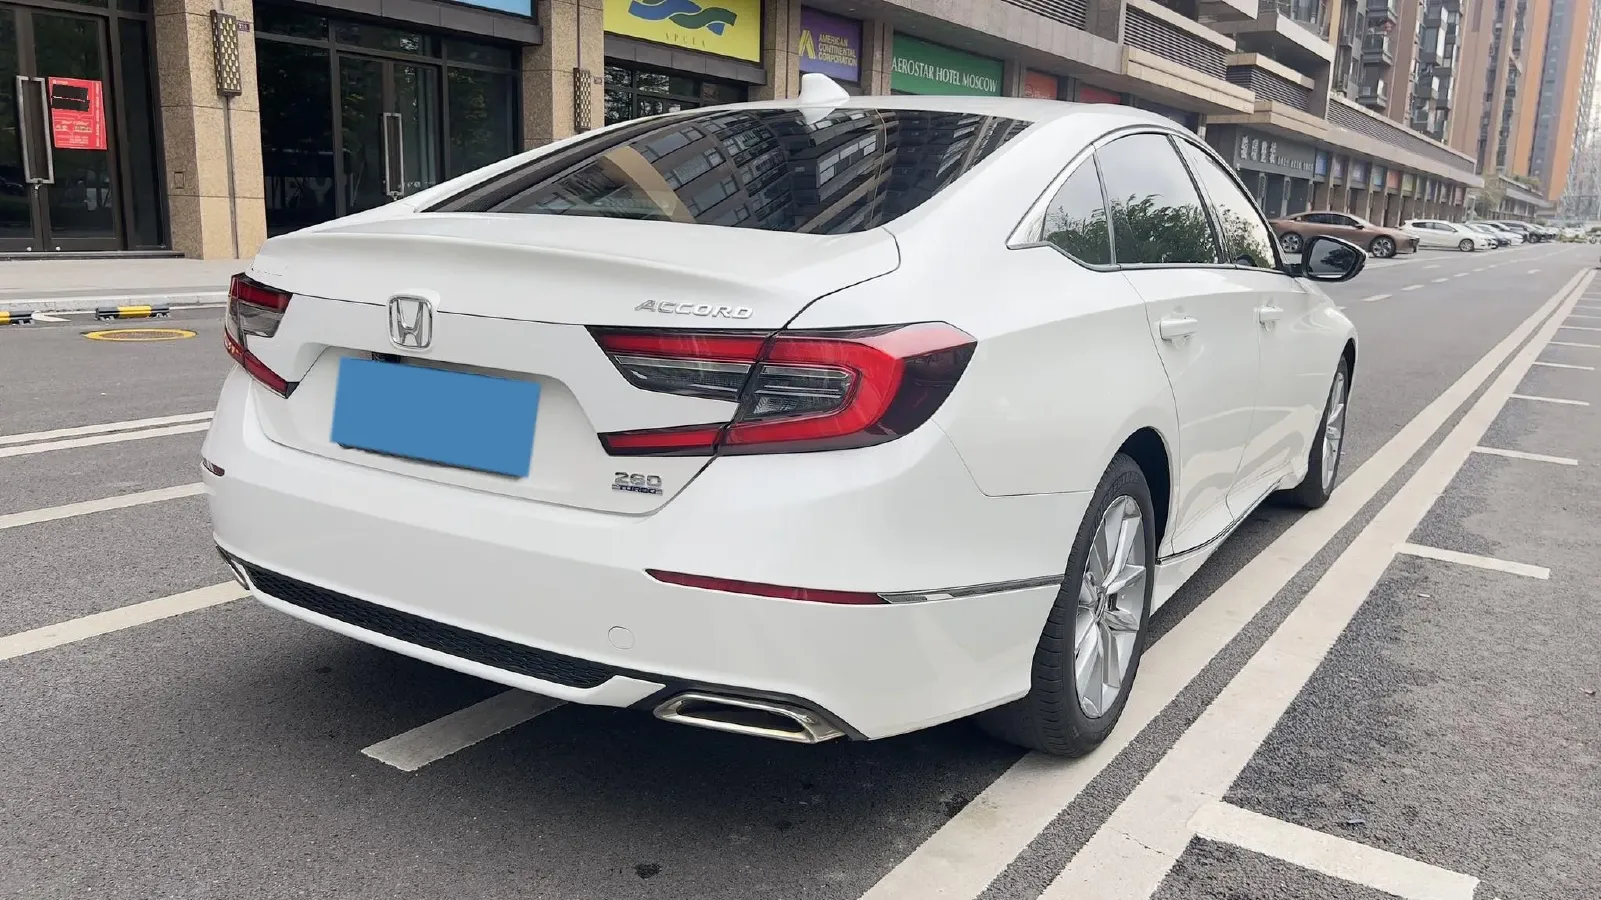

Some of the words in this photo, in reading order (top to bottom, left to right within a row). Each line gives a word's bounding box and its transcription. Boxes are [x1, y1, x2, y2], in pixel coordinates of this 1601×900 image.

[819, 33, 849, 47] AMERICAN
[818, 42, 857, 58] CONTINENTAL
[818, 52, 858, 67] CORPORATION
[891, 56, 934, 80] AEROSTAR
[936, 66, 961, 86] HOTEL
[962, 73, 998, 93] MOSCOW
[634, 299, 753, 319] ACCORD
[614, 471, 662, 487] 260
[617, 484, 658, 494] TURBO
